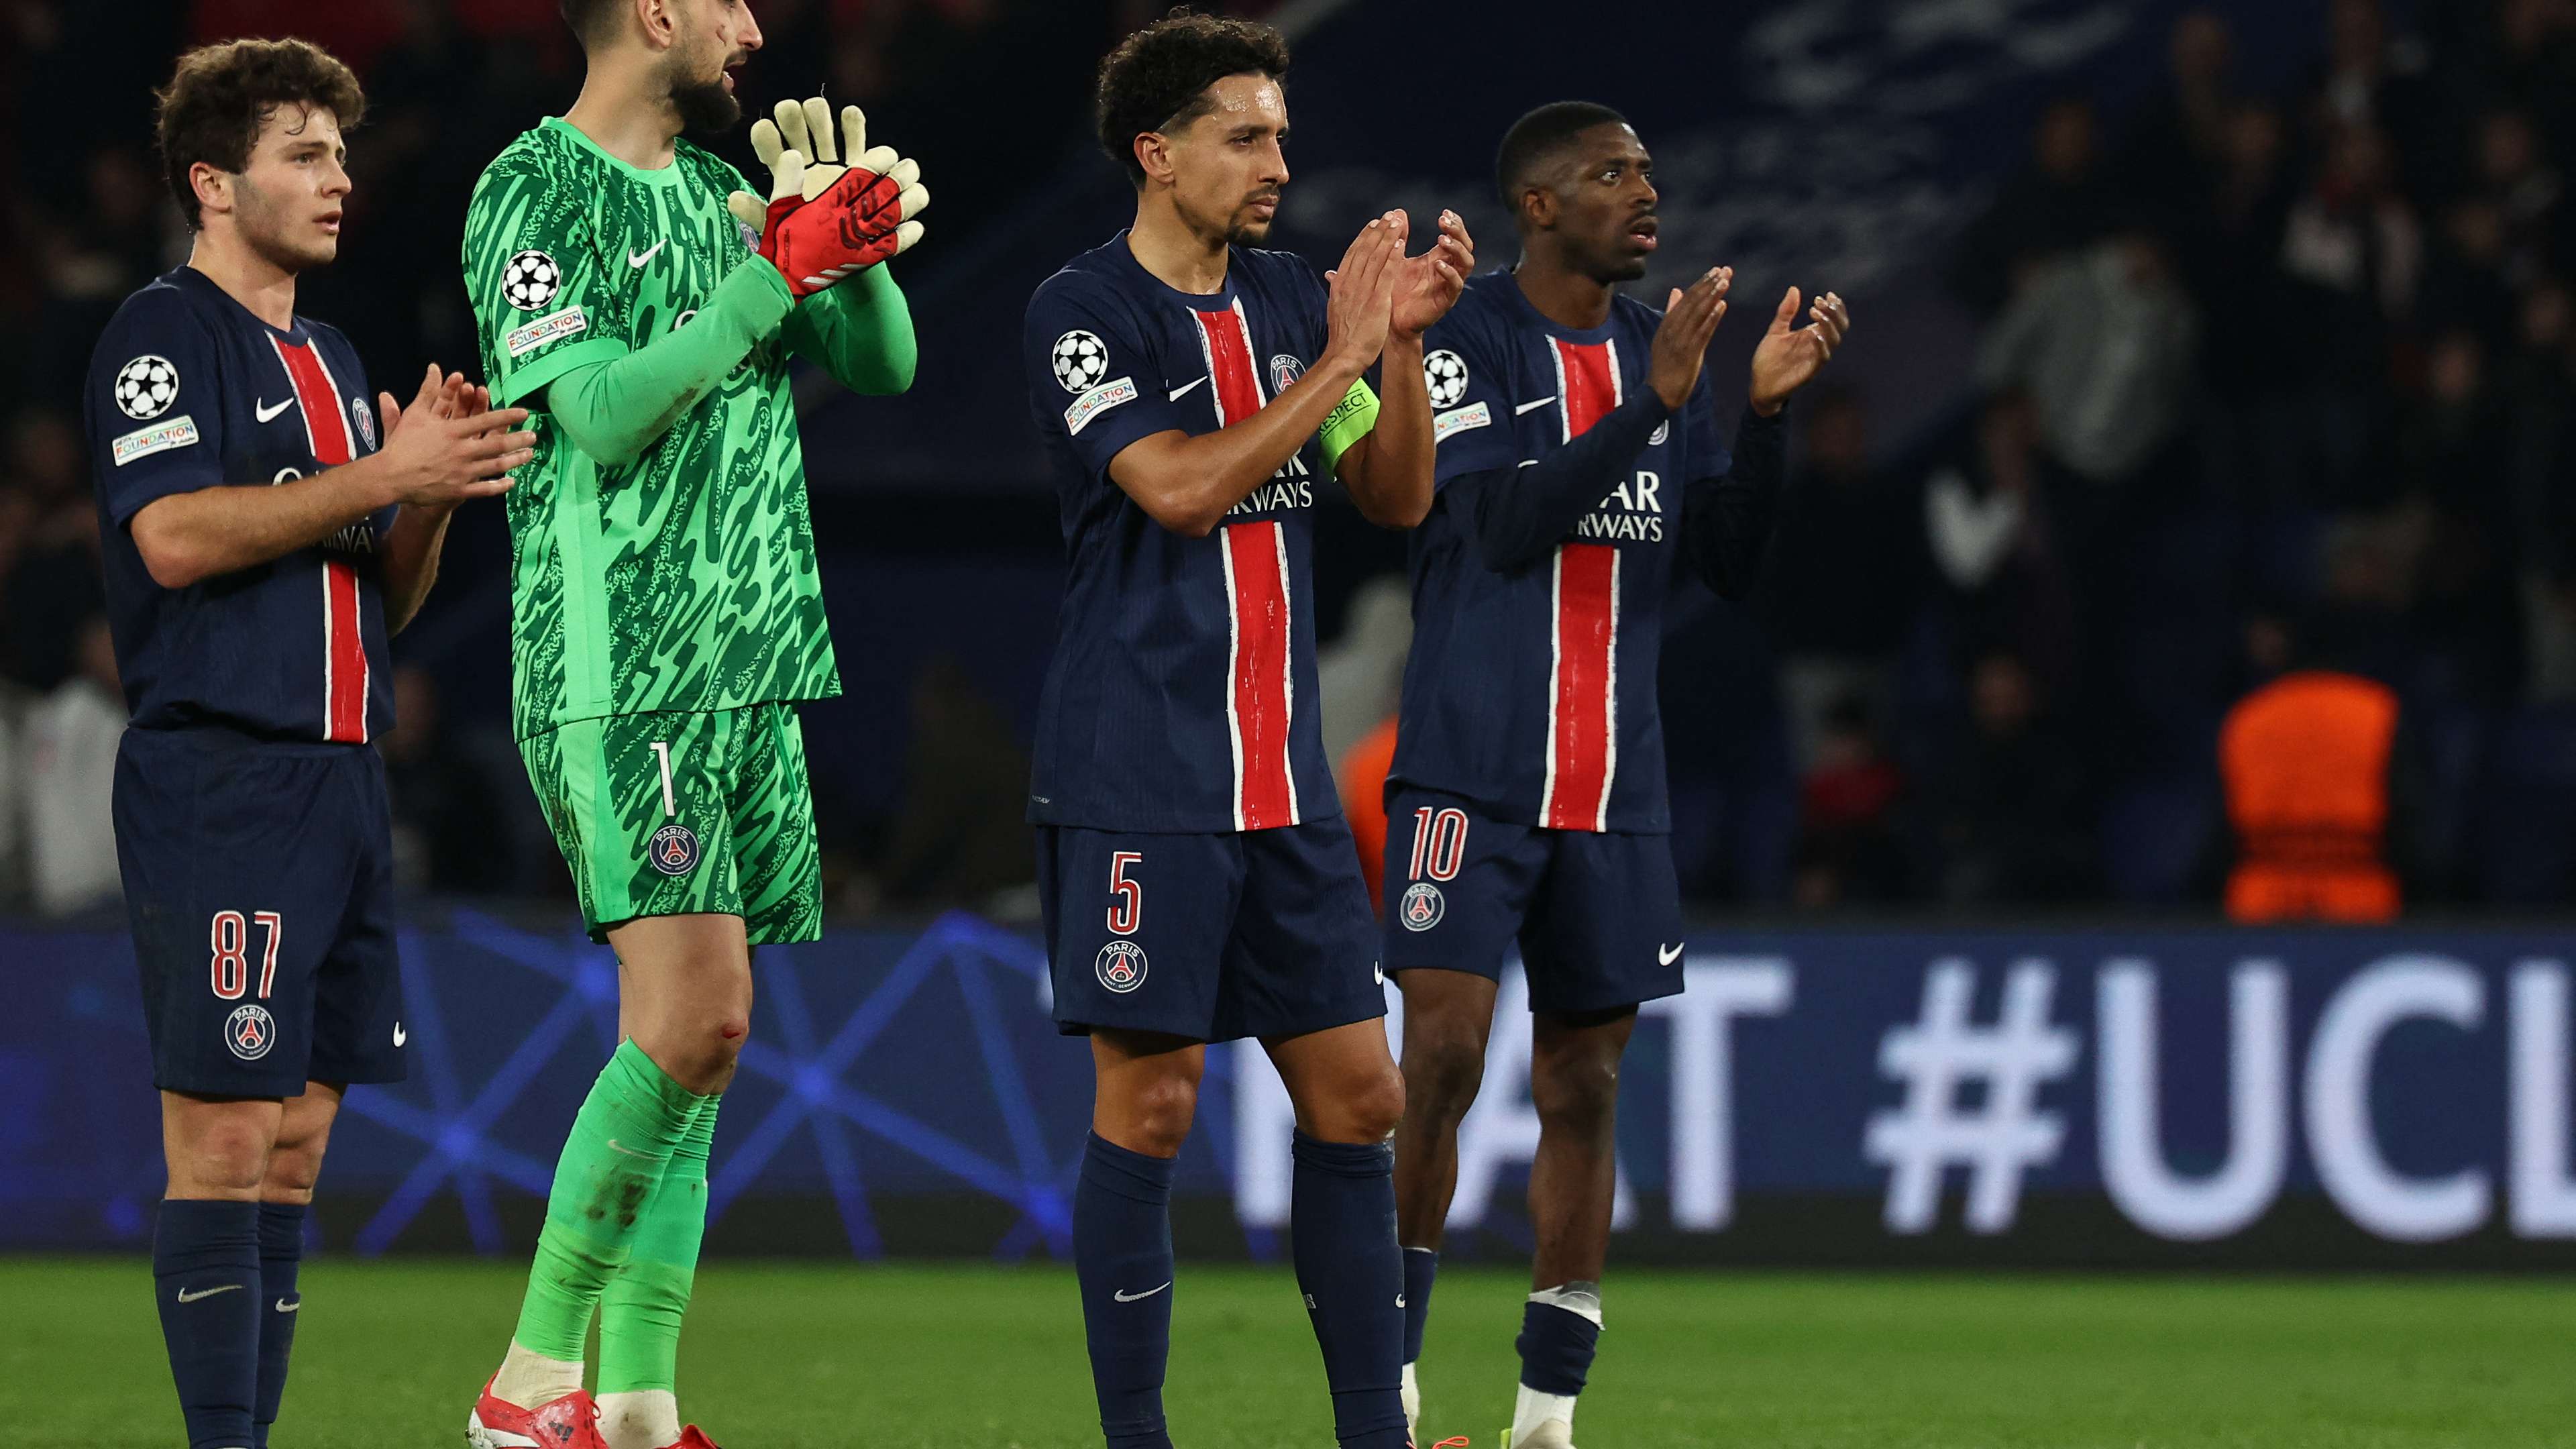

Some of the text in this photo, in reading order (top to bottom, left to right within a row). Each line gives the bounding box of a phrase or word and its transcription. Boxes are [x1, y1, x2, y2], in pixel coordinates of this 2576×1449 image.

[509, 313, 581, 347] FOUNDATION
[1273, 357, 1297, 370] PARIS
[1069, 384, 1133, 427] FOUNDATION
[1438, 411, 1486, 430] NDATION
[116, 425, 193, 455] FOUNDATION
[1226, 481, 1313, 515] WAYS
[1578, 513, 1663, 543] RWAYS
[649, 742, 676, 816] 1
[655, 828, 689, 842] PARIS
[1409, 806, 1469, 881] 10
[1107, 851, 1142, 935] 5
[211, 910, 282, 1000] 87
[1106, 943, 1140, 958] PARIS
[234, 1008, 267, 1022] PARIS
[1862, 954, 2576, 1241] #UCL
